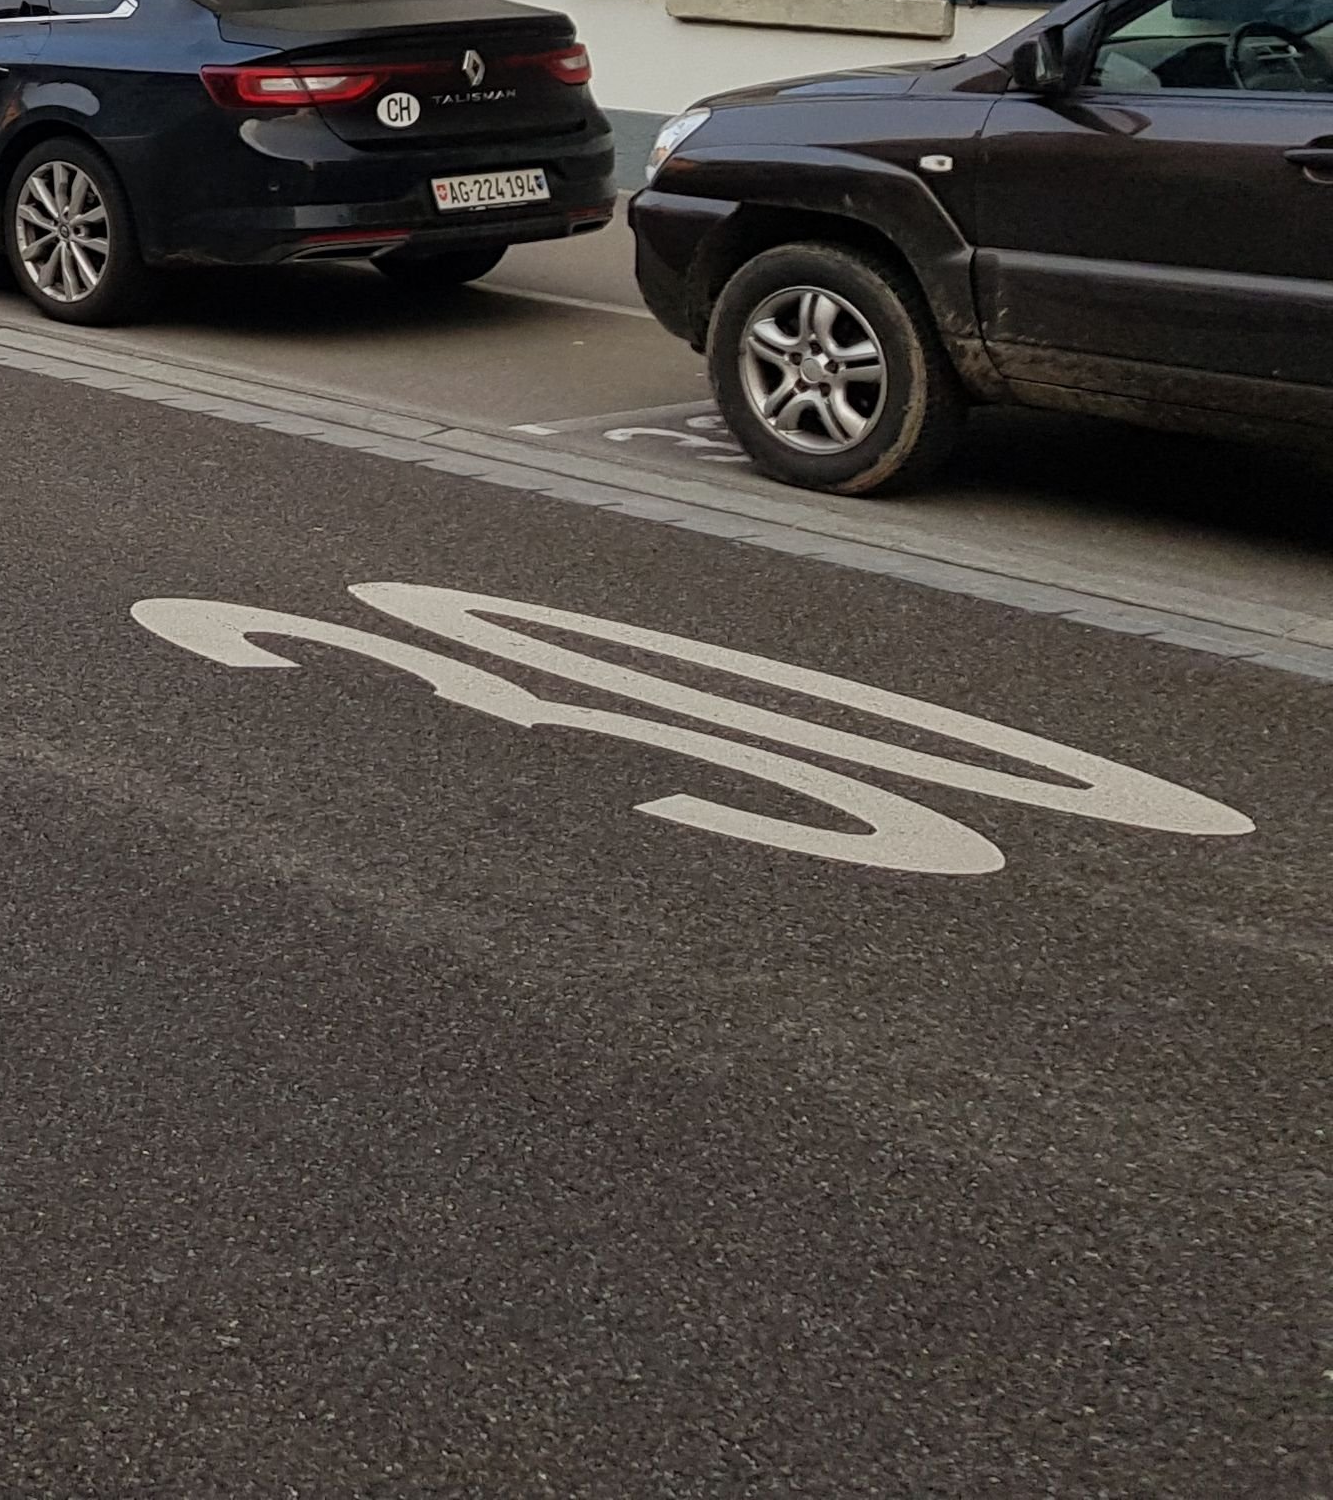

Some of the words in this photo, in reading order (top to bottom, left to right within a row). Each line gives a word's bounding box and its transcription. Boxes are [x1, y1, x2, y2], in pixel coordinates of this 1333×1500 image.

[432, 89, 517, 104] TALISMAN
[387, 97, 411, 122] CH
[131, 582, 1256, 875] 30
